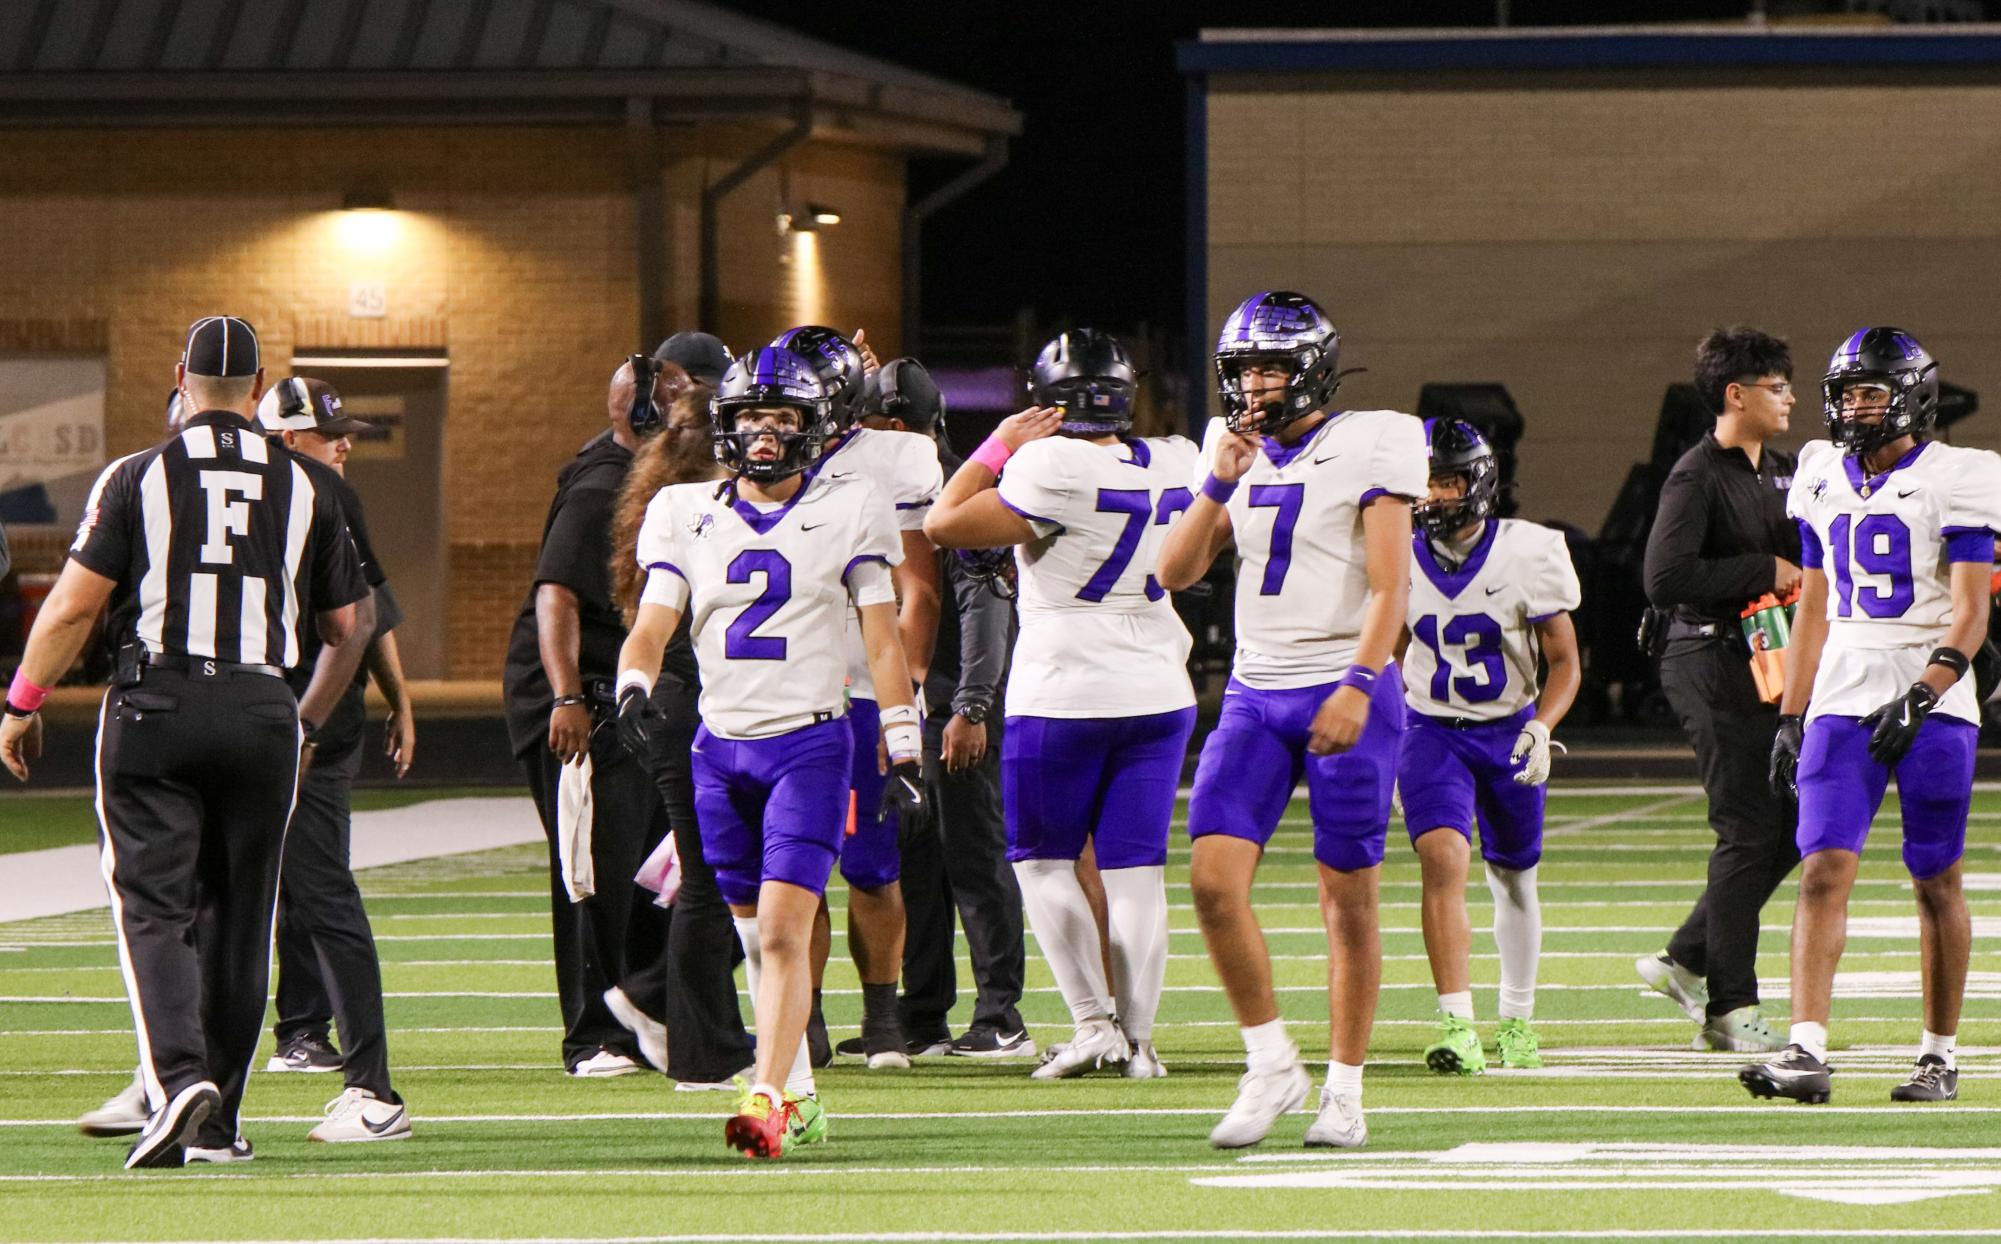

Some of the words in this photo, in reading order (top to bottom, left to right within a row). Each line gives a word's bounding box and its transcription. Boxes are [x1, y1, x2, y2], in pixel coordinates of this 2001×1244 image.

[355, 286, 384, 311] 45
[199, 470, 263, 565] F
[1248, 482, 1305, 596] 7
[1828, 513, 1915, 619] 19
[725, 548, 792, 660] 2
[1413, 612, 1508, 704] 13
